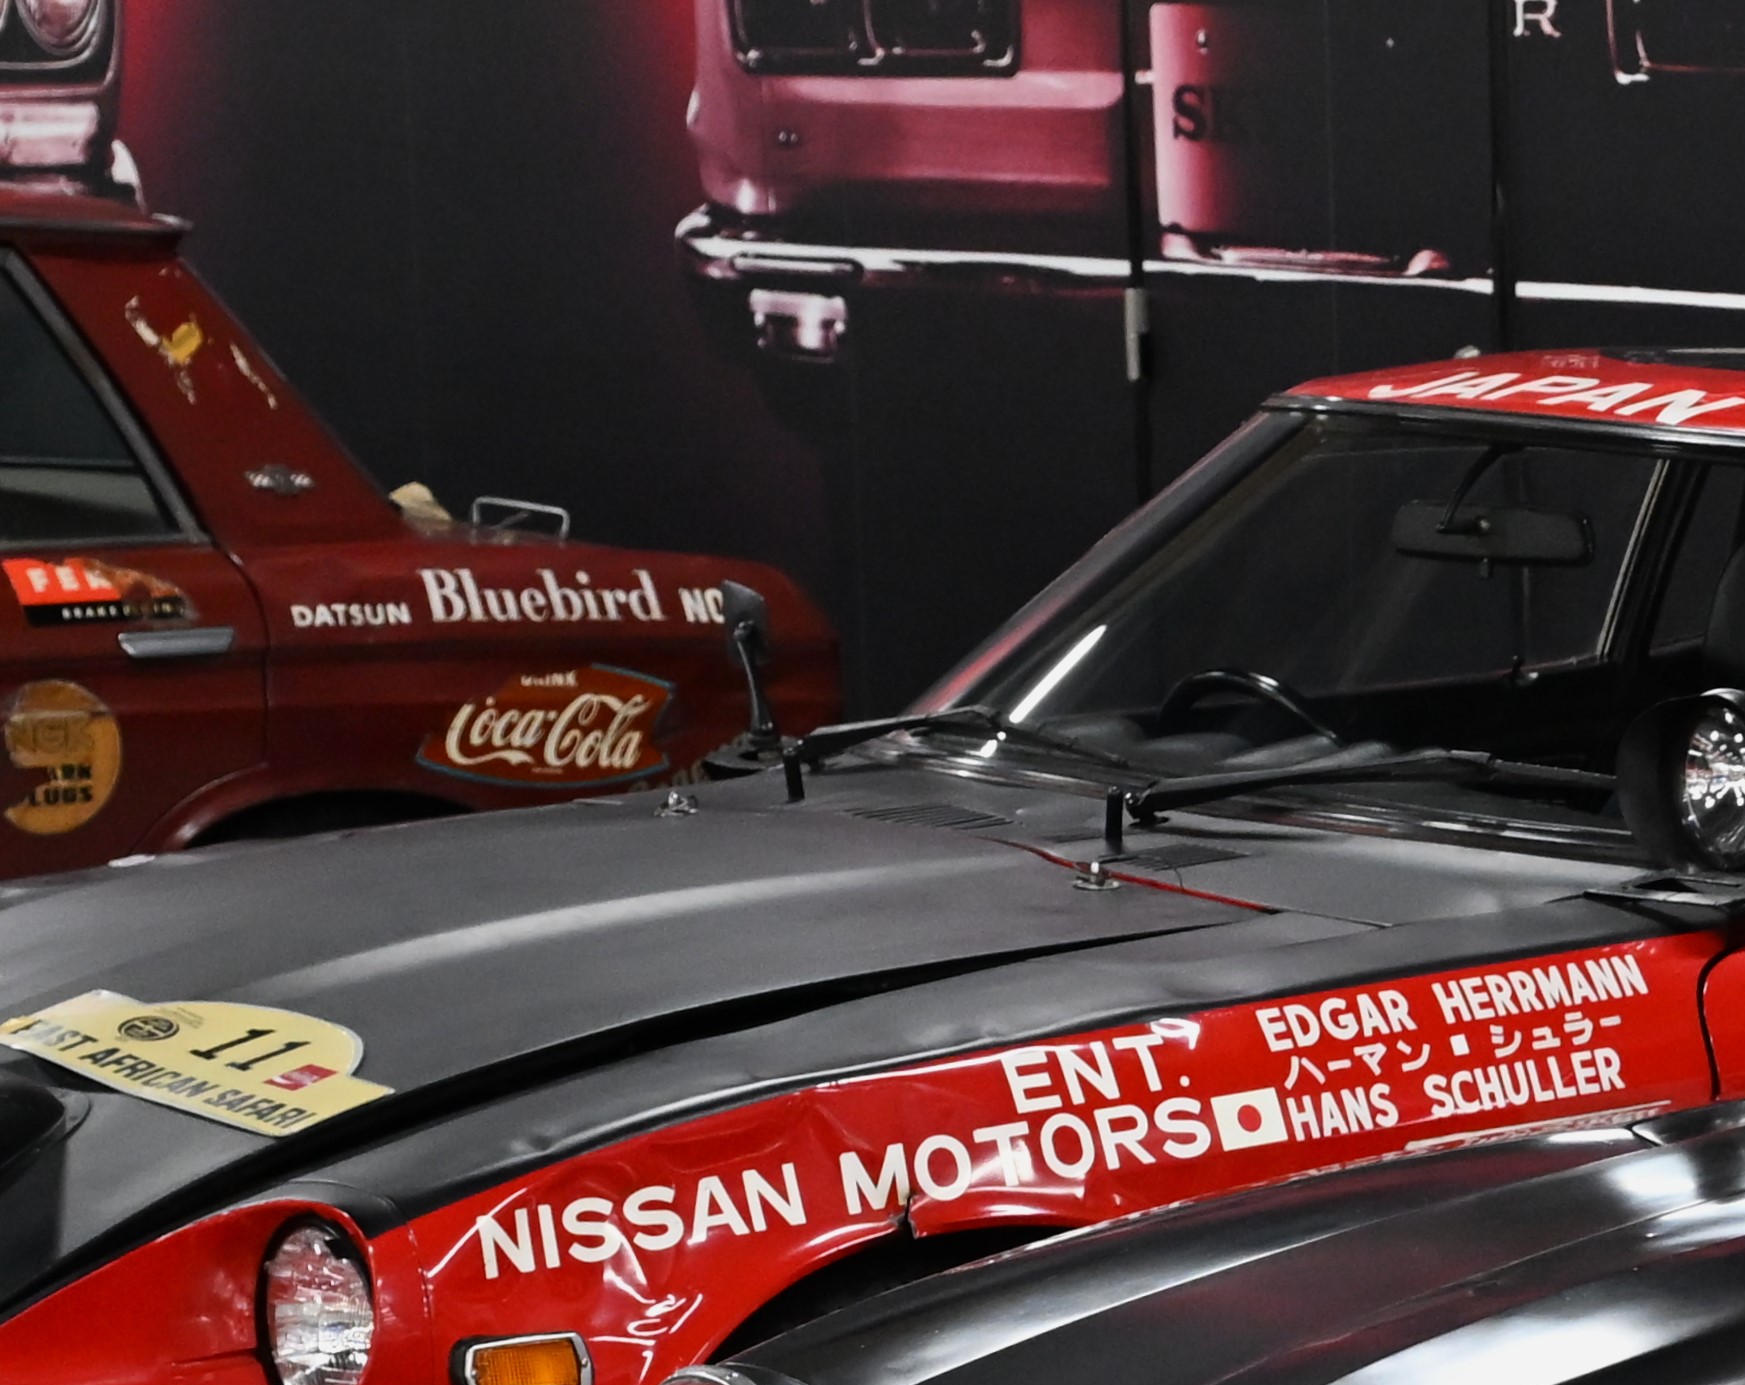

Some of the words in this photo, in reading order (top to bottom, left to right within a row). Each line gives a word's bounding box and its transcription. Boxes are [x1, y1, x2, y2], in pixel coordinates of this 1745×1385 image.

[290, 602, 411, 628] DATSUN
[416, 567, 668, 623] Bluebird
[445, 692, 652, 769] Coca-Cola
[1255, 988, 1418, 1054] EDGAR
[1431, 953, 1650, 1025] HERRMANN
[79, 1046, 221, 1098] AFRICAN
[202, 1084, 318, 1130] SAFARI
[189, 1028, 311, 1072] 11
[1000, 1033, 1192, 1115] ENT.
[1285, 1082, 1400, 1143] HANS
[1422, 1046, 1627, 1118] SCHULLER
[477, 1162, 807, 1280] NISSAN
[839, 1097, 1213, 1217] MOTORS
